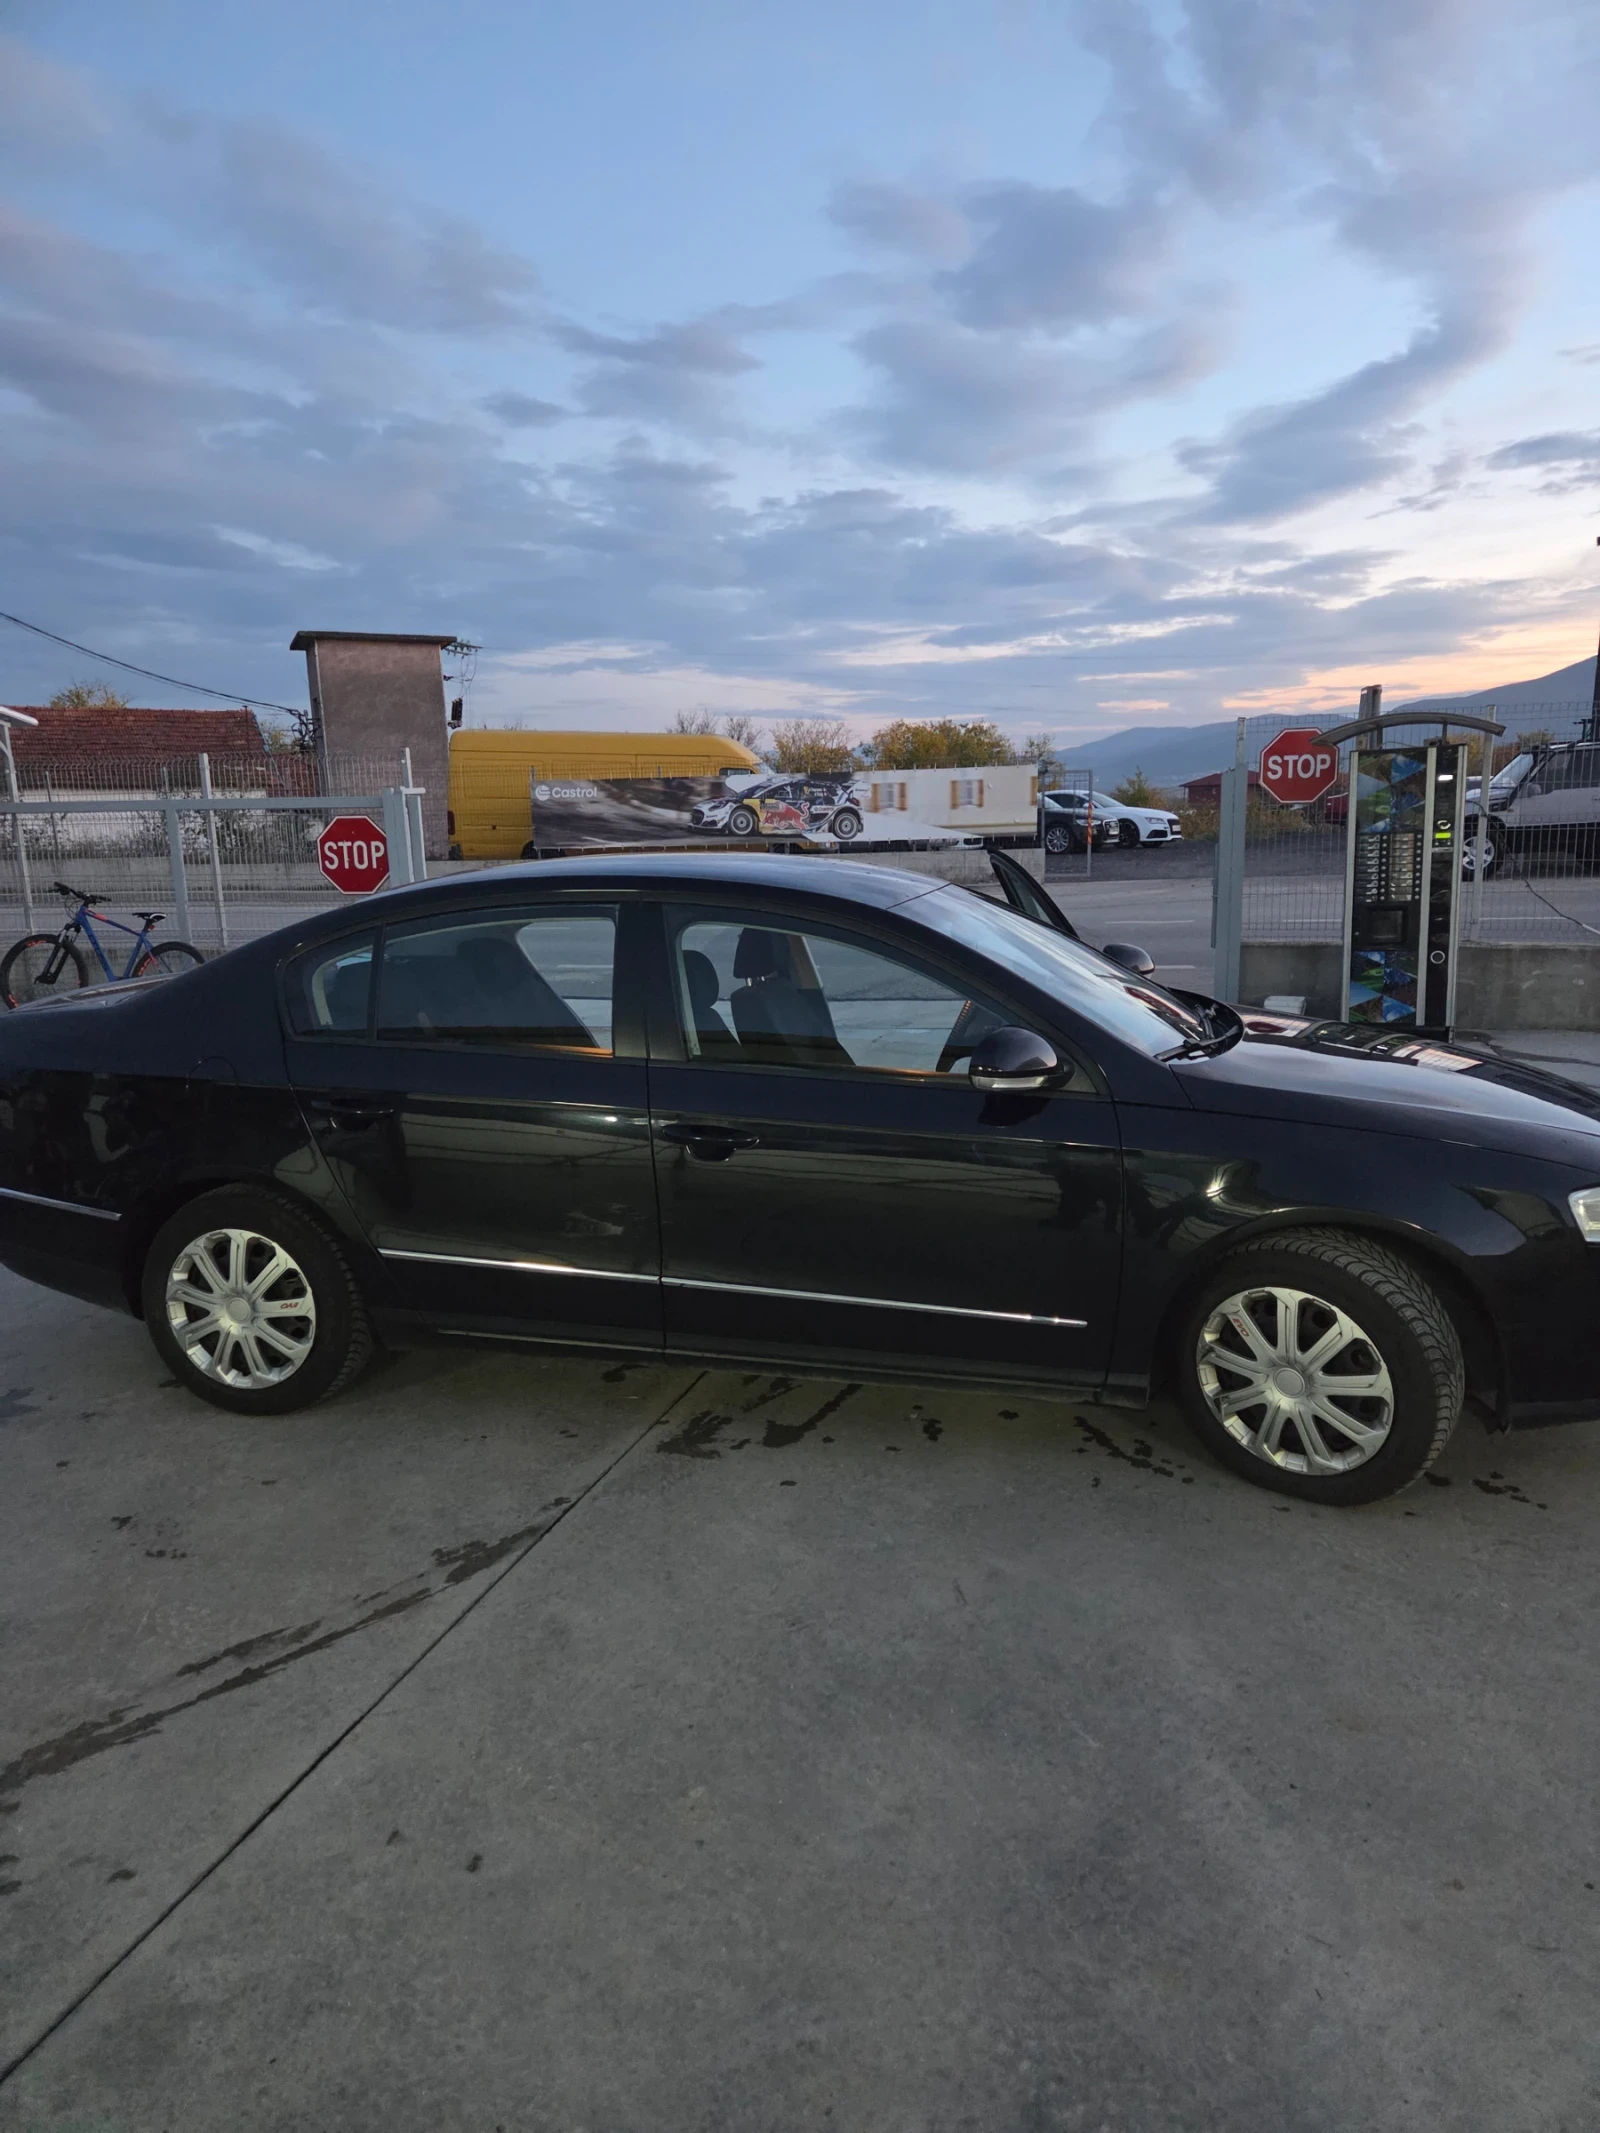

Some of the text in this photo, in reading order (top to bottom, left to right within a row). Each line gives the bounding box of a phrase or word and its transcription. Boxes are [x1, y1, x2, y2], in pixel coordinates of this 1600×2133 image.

[1267, 753, 1331, 780] STOP
[551, 786, 597, 798] Castrol
[324, 840, 385, 870] STOP
[1232, 1317, 1250, 1337] EVO
